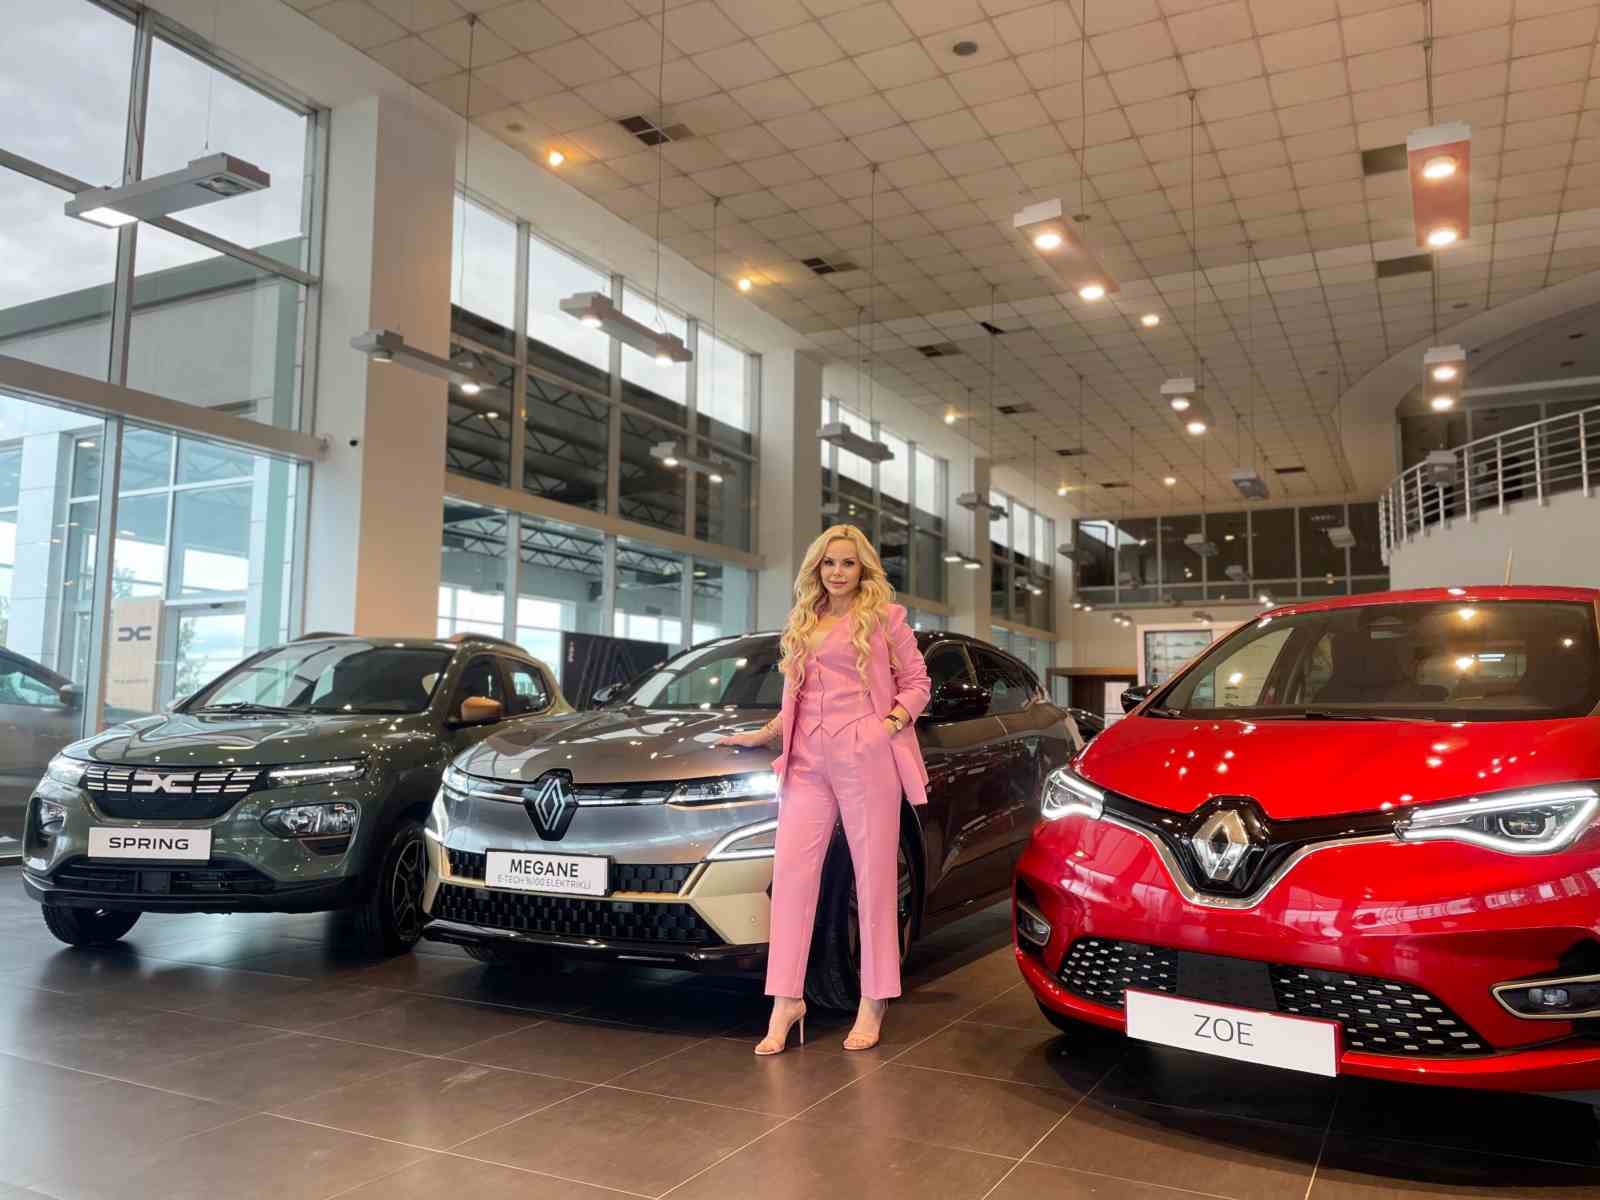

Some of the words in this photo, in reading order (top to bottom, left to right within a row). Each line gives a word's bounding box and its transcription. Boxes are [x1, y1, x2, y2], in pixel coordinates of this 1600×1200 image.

[109, 837, 189, 850] SPRING
[510, 859, 579, 878] MEGANE
[1193, 1014, 1254, 1047] ZOE
